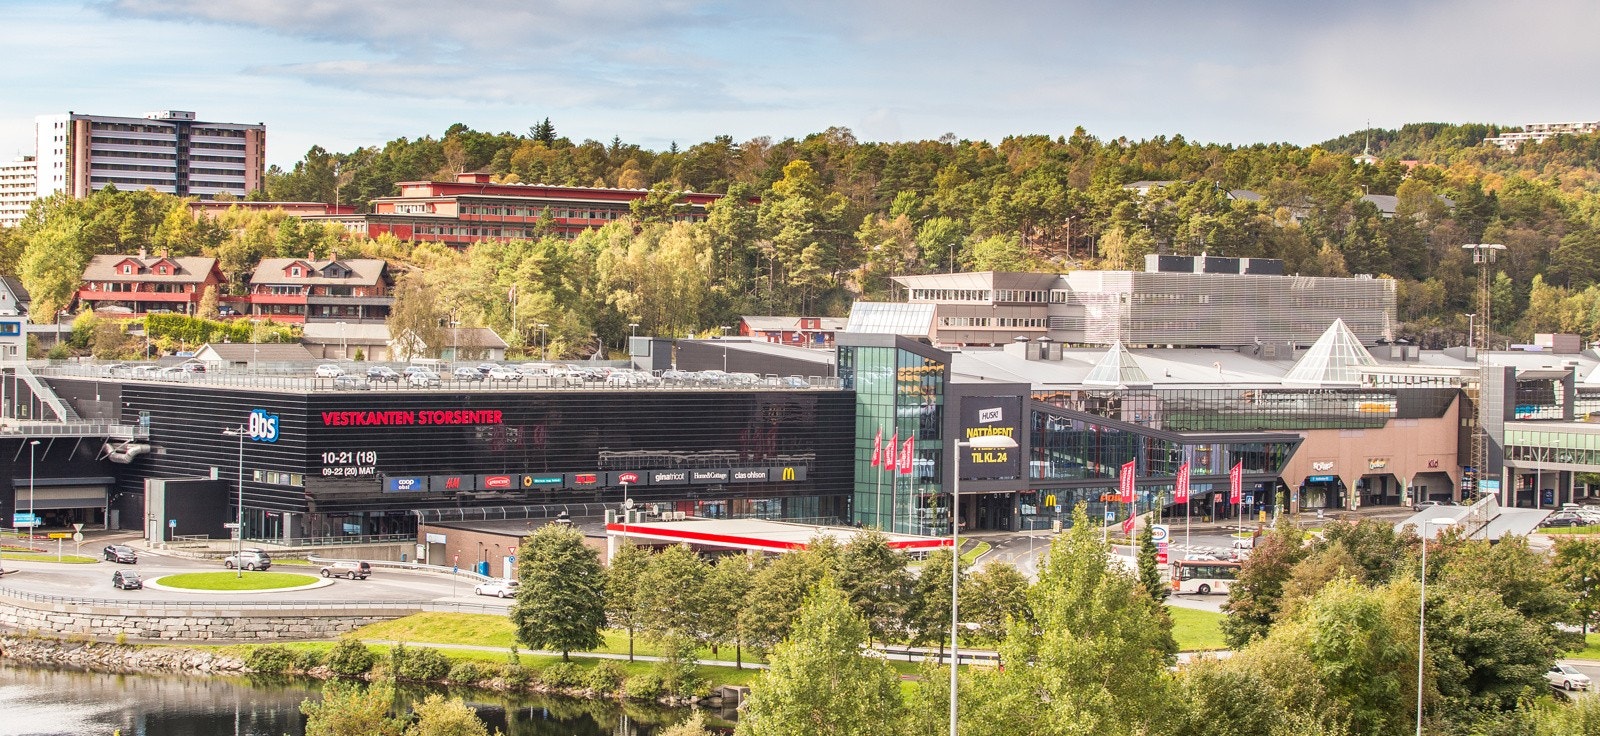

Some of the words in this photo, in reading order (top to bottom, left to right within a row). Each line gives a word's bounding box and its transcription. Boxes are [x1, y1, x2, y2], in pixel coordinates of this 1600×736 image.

[322, 411, 414, 425] VESTKANTEN
[418, 410, 503, 425] STORSENTER
[981, 411, 999, 420] HUSK!
[321, 452, 352, 464] 10-21
[356, 451, 377, 466] (18)
[971, 453, 983, 463] TIL
[997, 453, 1007, 463] 24
[322, 467, 343, 476] 09-22
[344, 467, 358, 477] (20)
[358, 467, 375, 475] MAT
[694, 472, 727, 480] Home&Cottage
[735, 471, 747, 479] clas
[747, 471, 766, 479] ohlson
[655, 473, 685, 482] ginatricot
